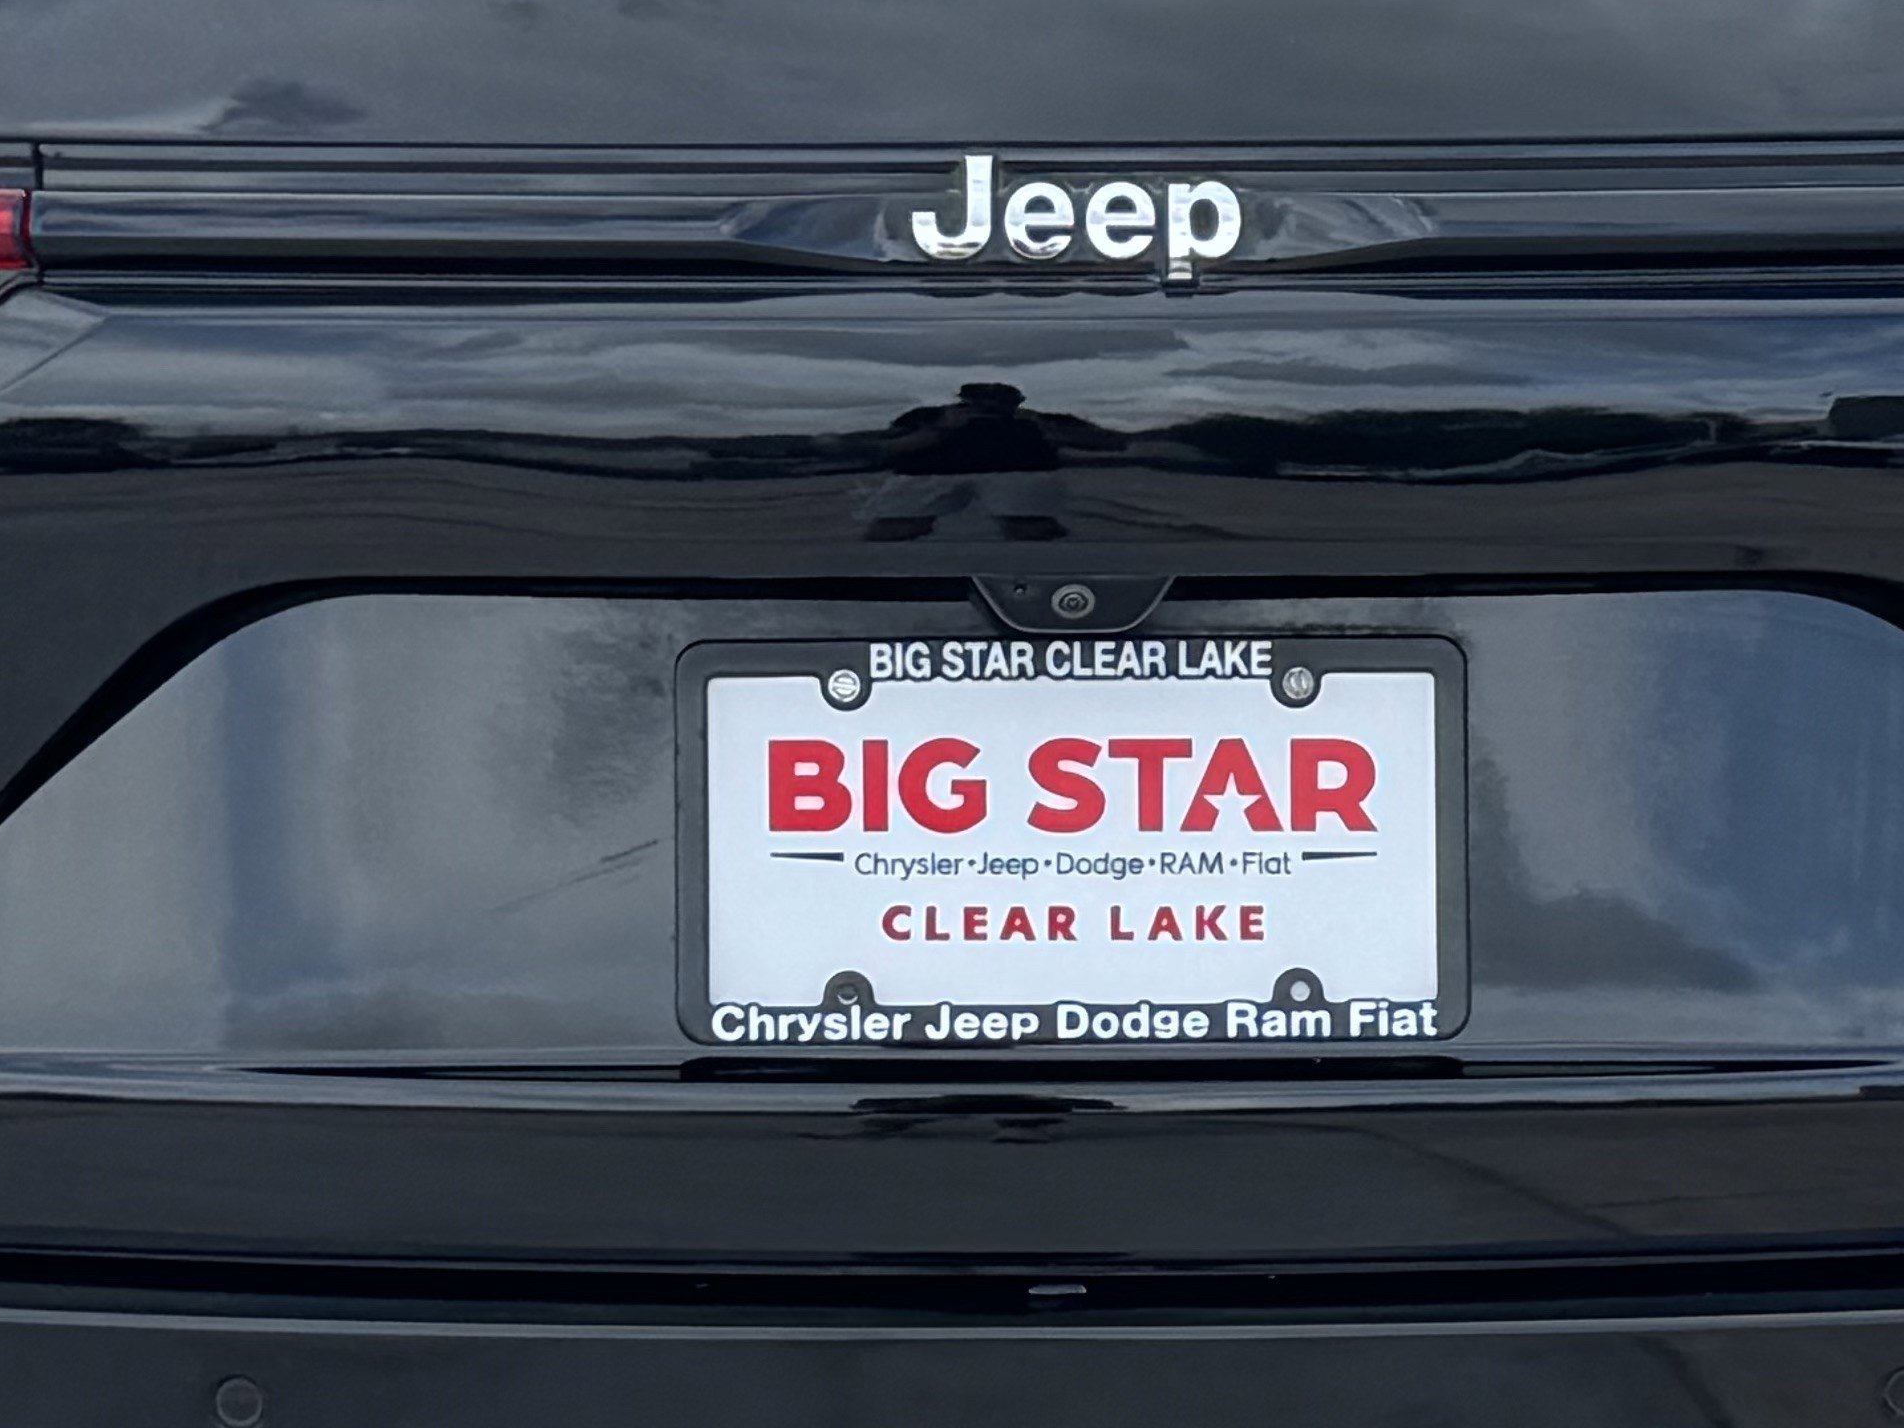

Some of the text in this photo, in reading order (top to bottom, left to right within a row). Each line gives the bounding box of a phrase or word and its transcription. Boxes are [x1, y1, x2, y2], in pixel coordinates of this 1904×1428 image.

[911, 155, 1243, 281] Jeep
[870, 641, 1273, 678] BIG STAR CLEAR LAKE
[768, 737, 1378, 834] BIG STAR
[881, 904, 1266, 941] CLEAR LAKE
[711, 1000, 1438, 1042] Chrysler Jeep Dodge Ram Fiat
